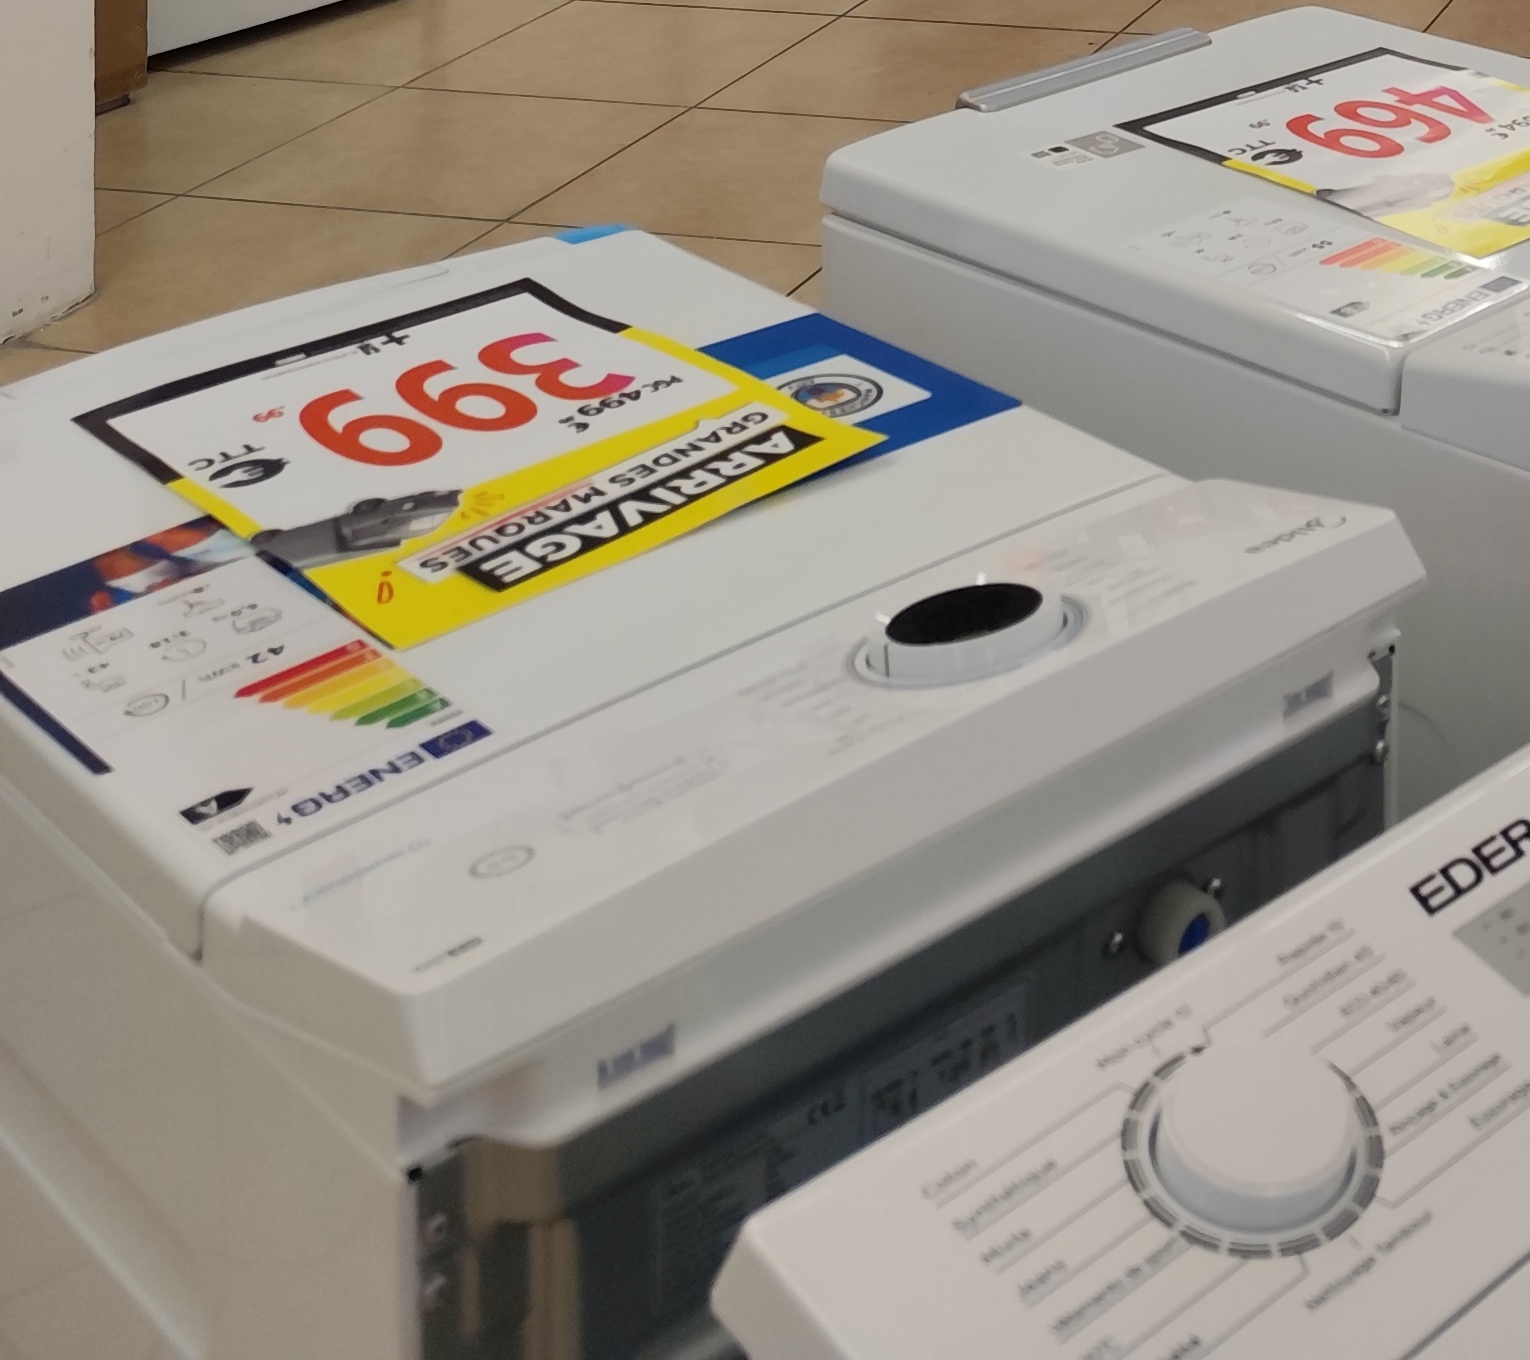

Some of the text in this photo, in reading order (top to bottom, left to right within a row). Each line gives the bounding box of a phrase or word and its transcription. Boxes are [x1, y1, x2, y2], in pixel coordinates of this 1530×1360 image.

[1228, 139, 1276, 156] TTC
[1286, 85, 1495, 159] 469
[299, 332, 635, 467] 399
[187, 443, 291, 490] TTC €
[418, 409, 770, 575] GRANDES MARQUES
[480, 428, 797, 585] ARRIVAGE
[290, 749, 428, 819] ENERG
